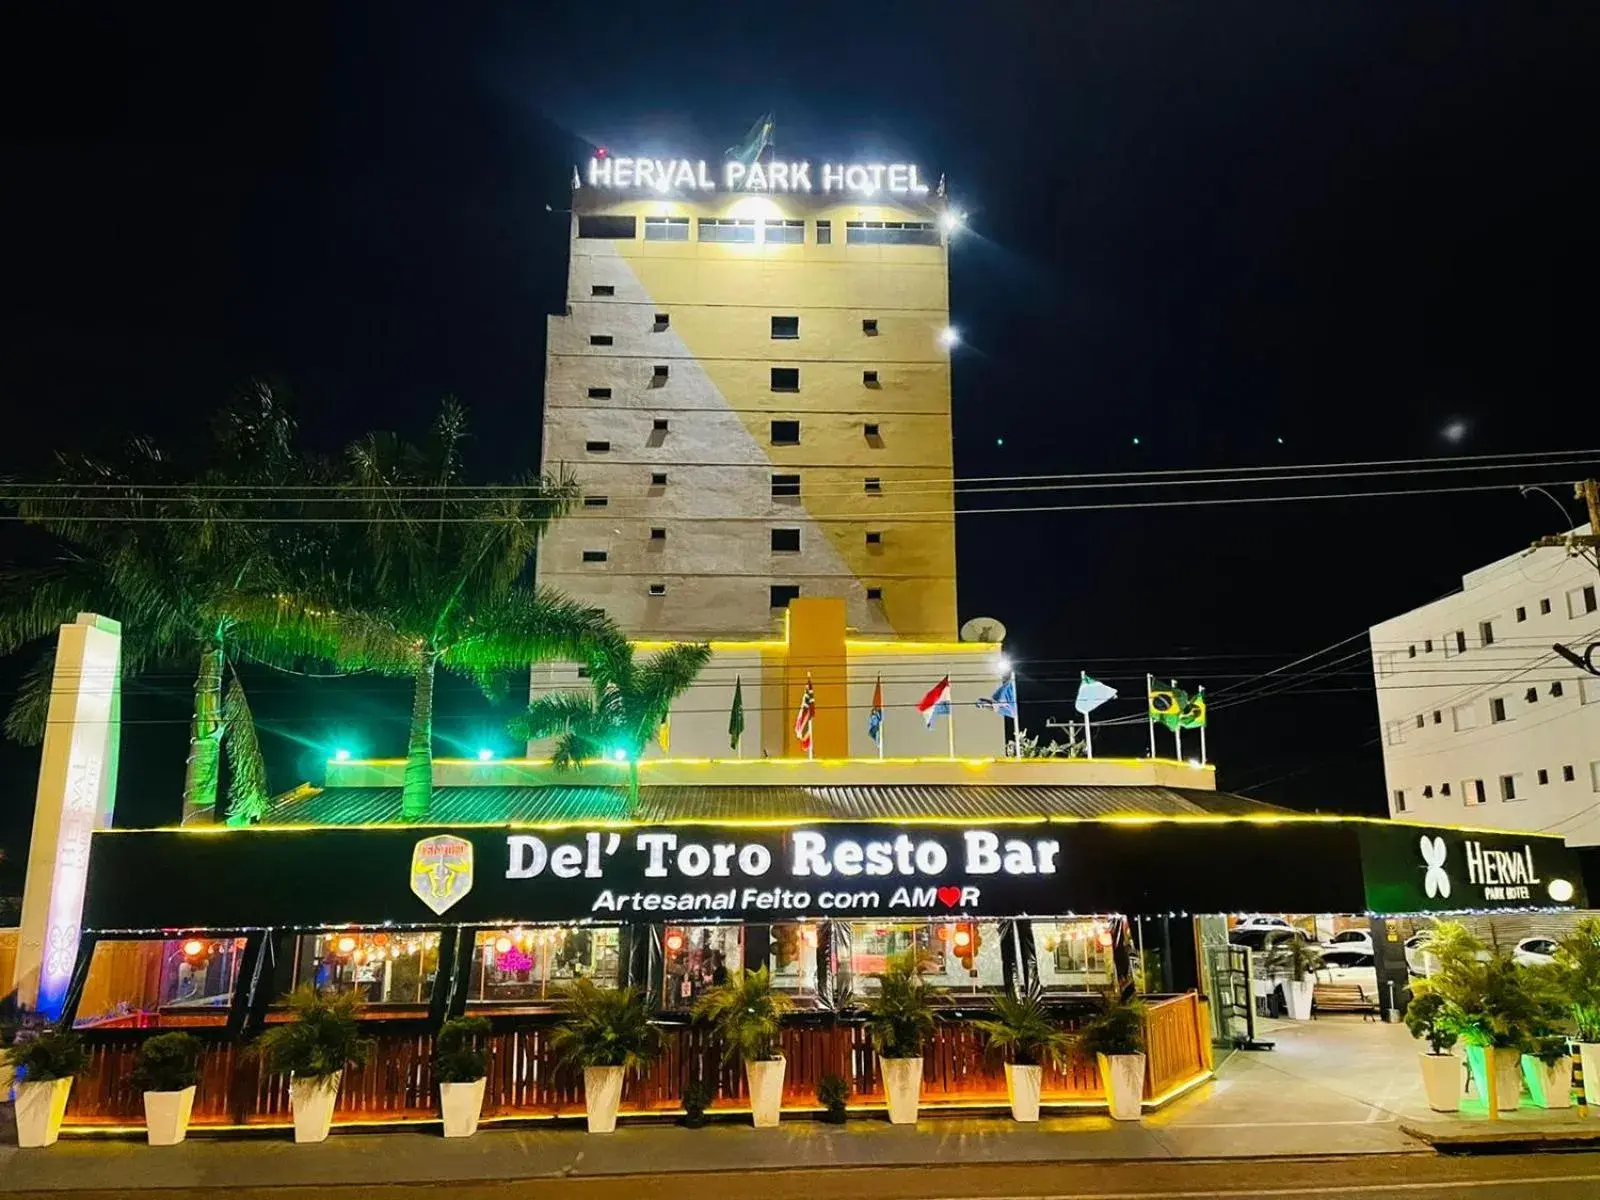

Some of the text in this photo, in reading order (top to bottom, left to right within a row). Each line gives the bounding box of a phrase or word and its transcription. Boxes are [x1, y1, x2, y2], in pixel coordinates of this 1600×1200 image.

[589, 157, 929, 192] HERVAL PARK HOTEL
[505, 831, 1060, 879] Del' Toro Resto Bar
[1464, 841, 1540, 885] HERVAL
[592, 888, 736, 912] Artesanal
[741, 887, 811, 910] Feito
[818, 890, 879, 909] com
[1484, 886, 1531, 901] PARK HOTEL
